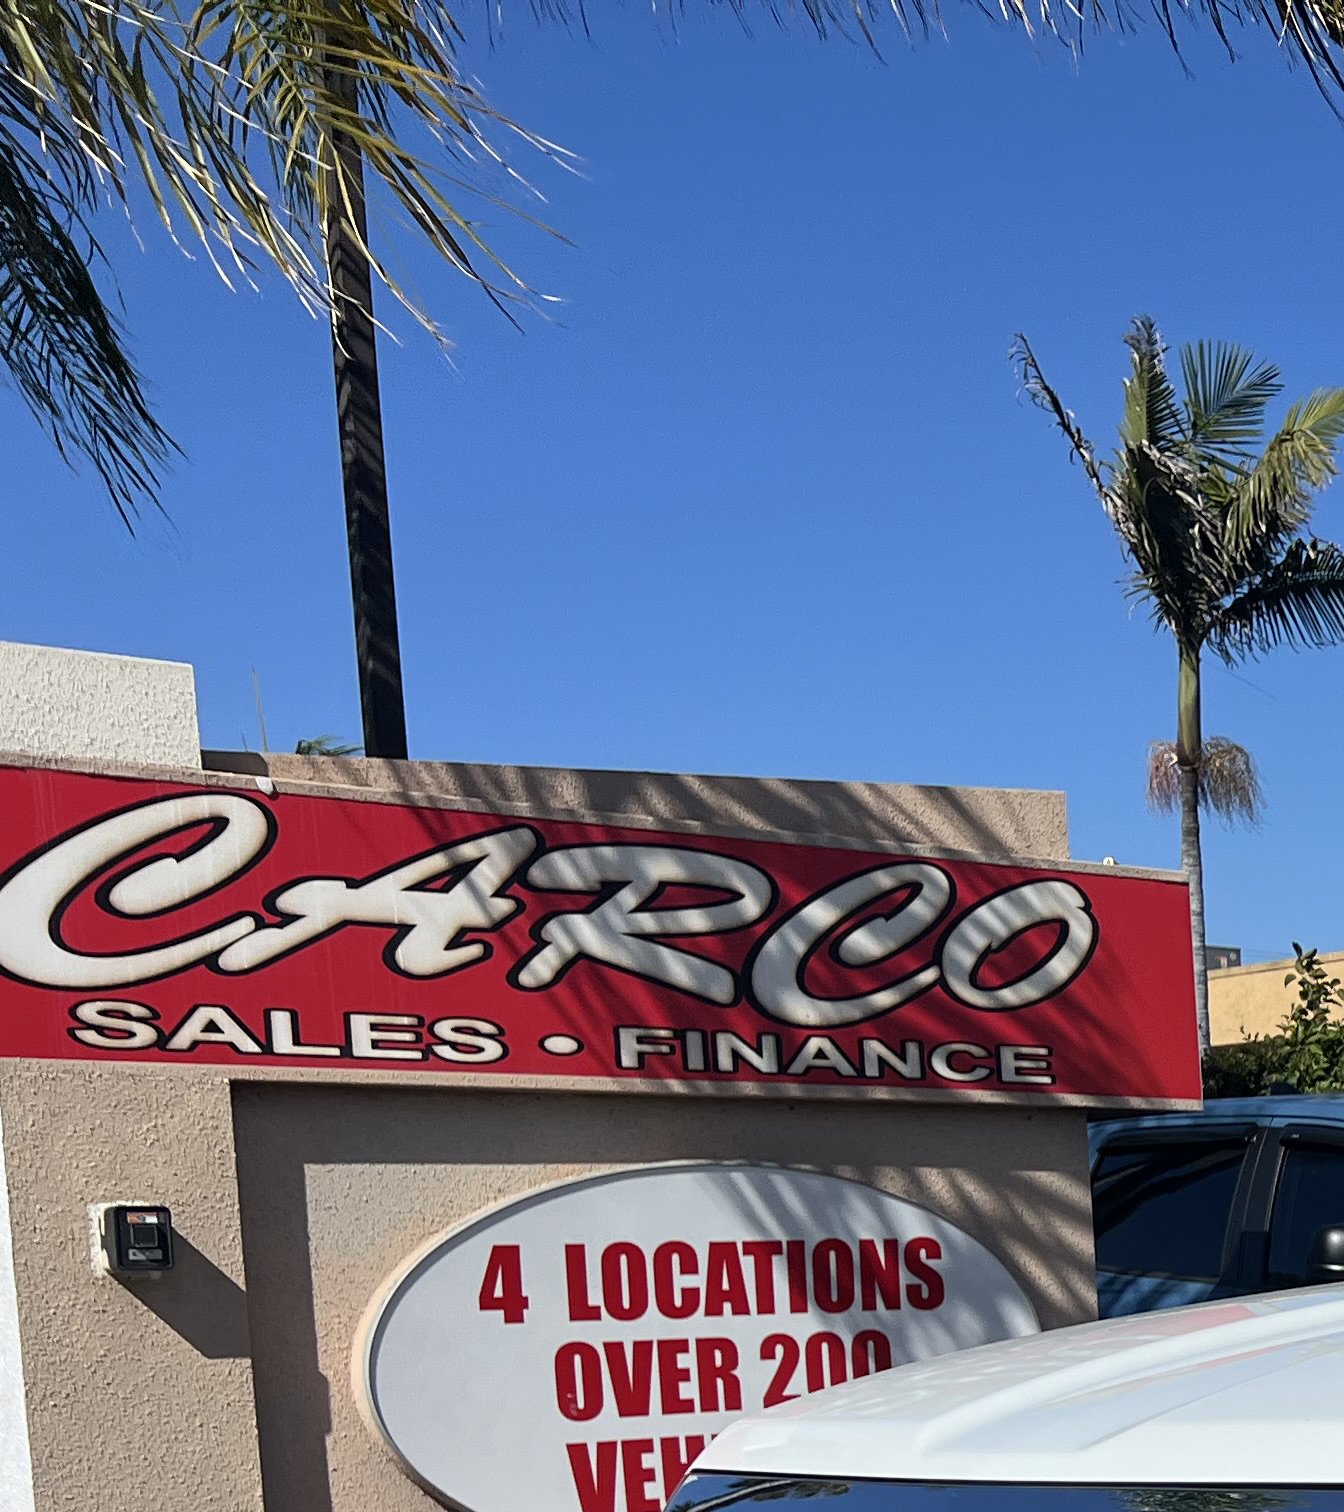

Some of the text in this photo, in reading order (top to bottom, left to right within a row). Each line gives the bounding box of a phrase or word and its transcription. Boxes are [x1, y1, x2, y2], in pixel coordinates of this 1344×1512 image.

[0, 790, 1098, 1028] CARCO
[66, 1000, 1060, 1086] SALES FINANCE
[479, 1236, 946, 1324] 4 LOCATIONS
[554, 1337, 743, 1422] OVER
